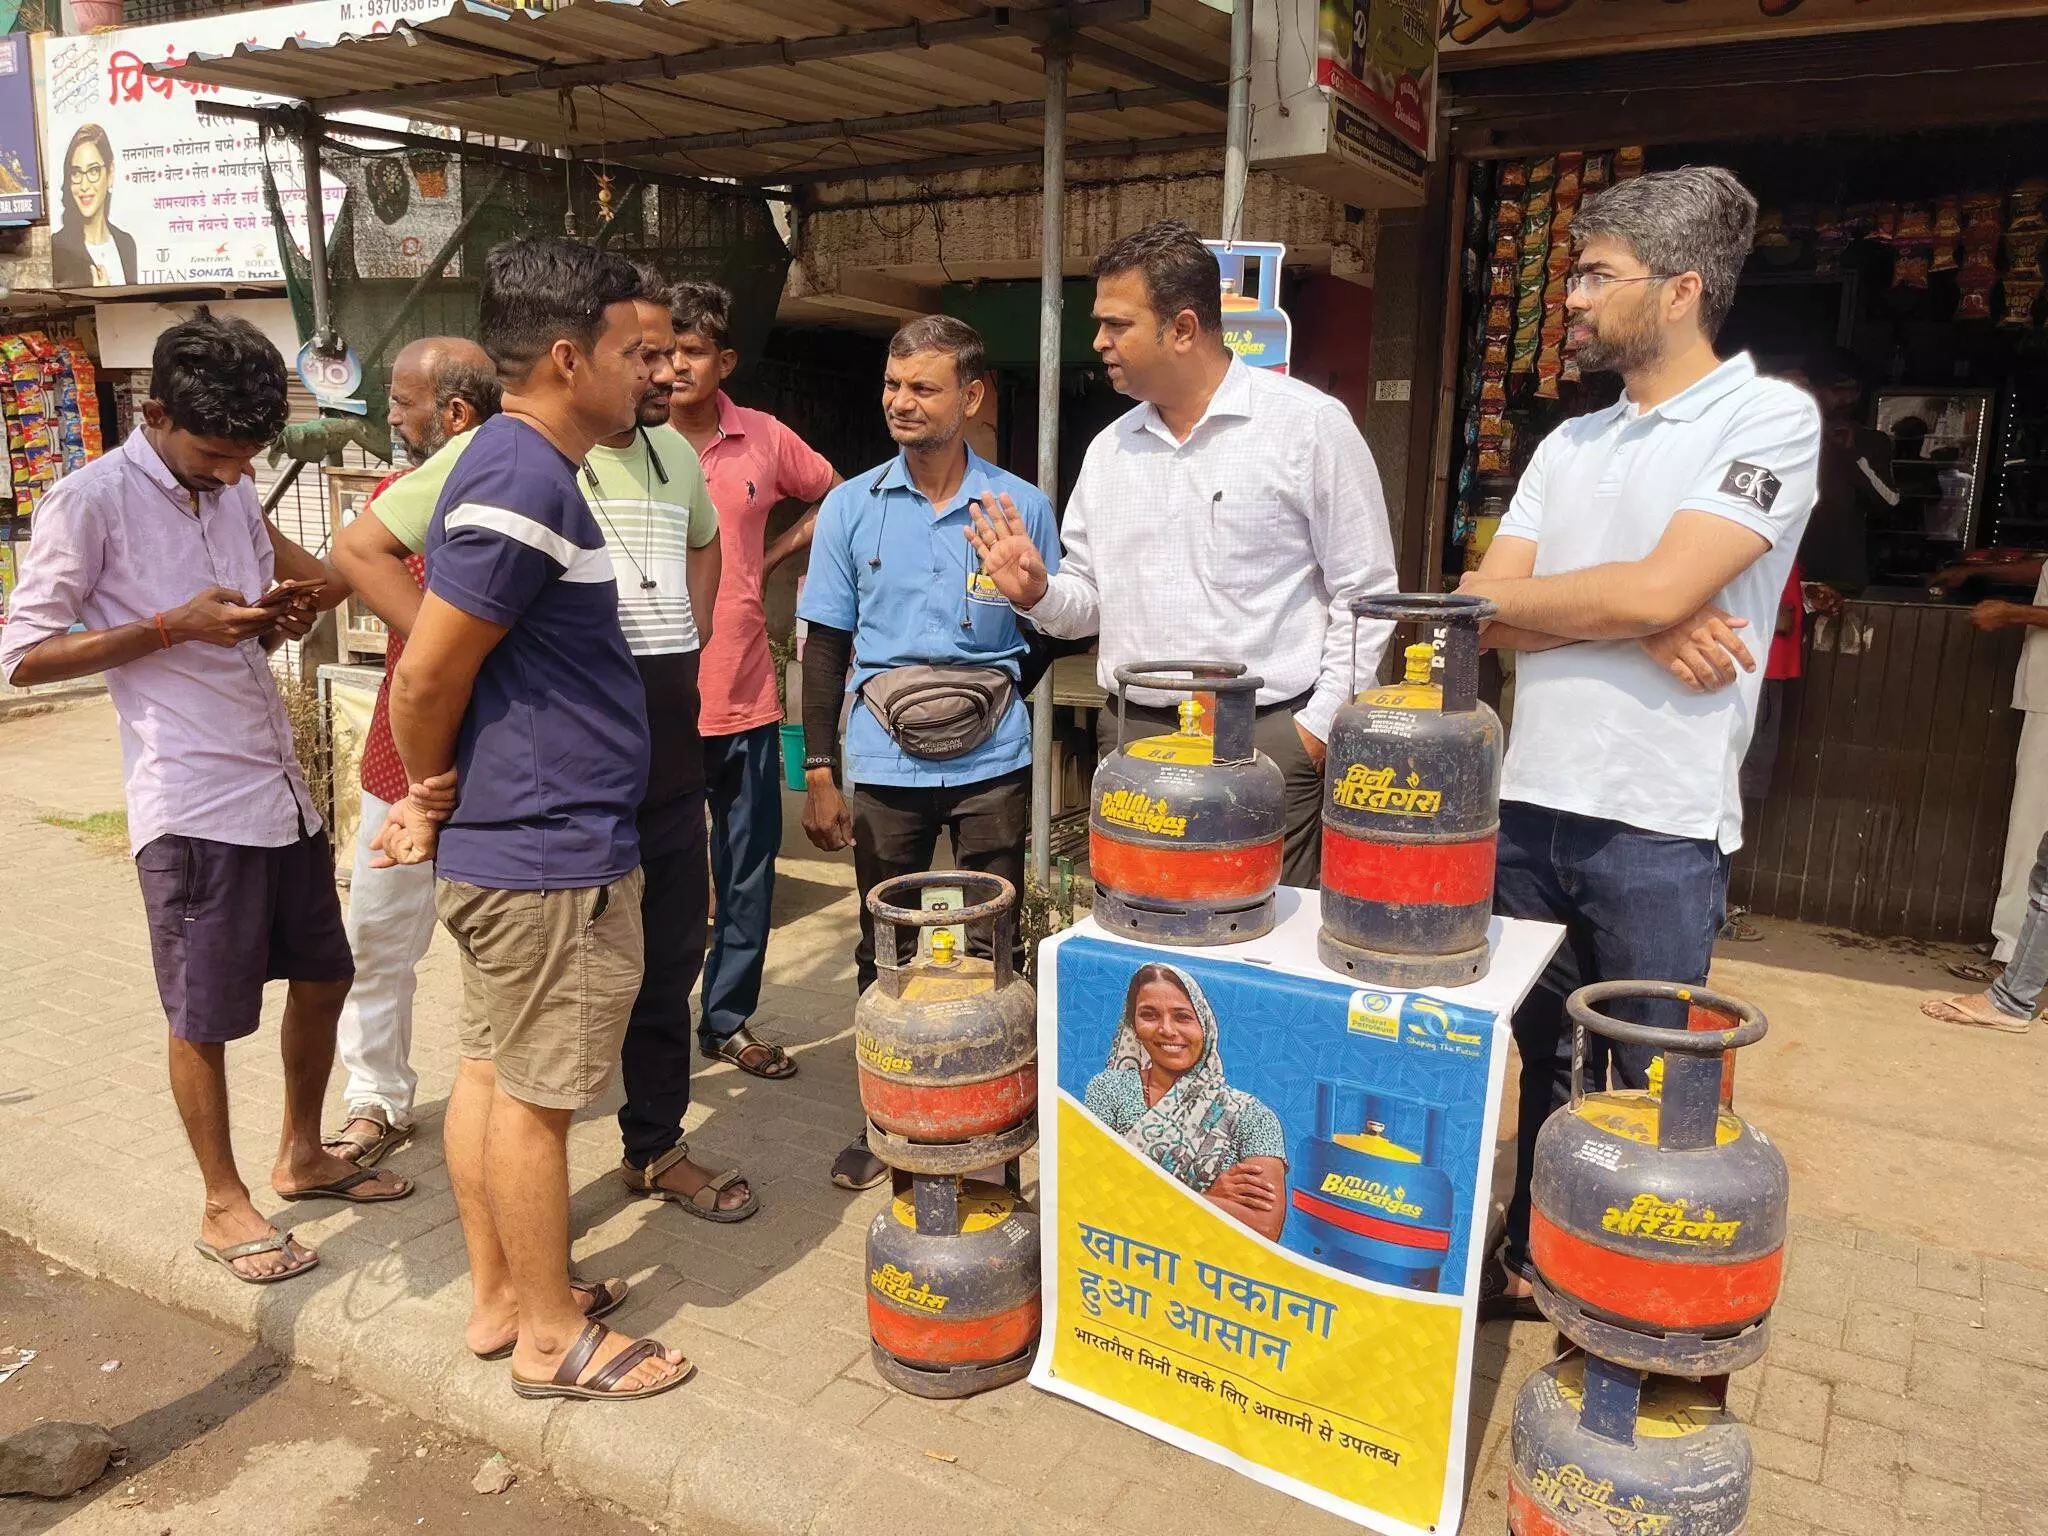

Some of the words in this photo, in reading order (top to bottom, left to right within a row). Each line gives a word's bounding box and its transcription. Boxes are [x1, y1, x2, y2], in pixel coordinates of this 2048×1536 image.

[13, 199, 33, 213] STORE
[140, 269, 188, 284] TITAN
[188, 267, 234, 279] SONATA
[919, 737, 961, 749] AMERICAN
[1352, 1019, 1395, 1035] Petroleum
[1359, 1014, 1387, 1027] Bharat
[1406, 1037, 1437, 1051] Shaping
[1440, 1043, 1456, 1053] The
[1320, 1173, 1424, 1216] Bharatgas
[1077, 1222, 1181, 1286] खाना
[1194, 1259, 1338, 1340] पकाना
[1077, 1267, 1152, 1320] हुआ
[1164, 1299, 1293, 1372] आसान
[1074, 1326, 1133, 1362] भारतगैस
[1138, 1348, 1171, 1378] मिनी
[1175, 1364, 1215, 1394] सबके
[1219, 1380, 1248, 1415] लिए
[1253, 1399, 1314, 1436] आसानी
[1318, 1419, 1335, 1443] से
[1338, 1432, 1401, 1468] उपलब्ध
